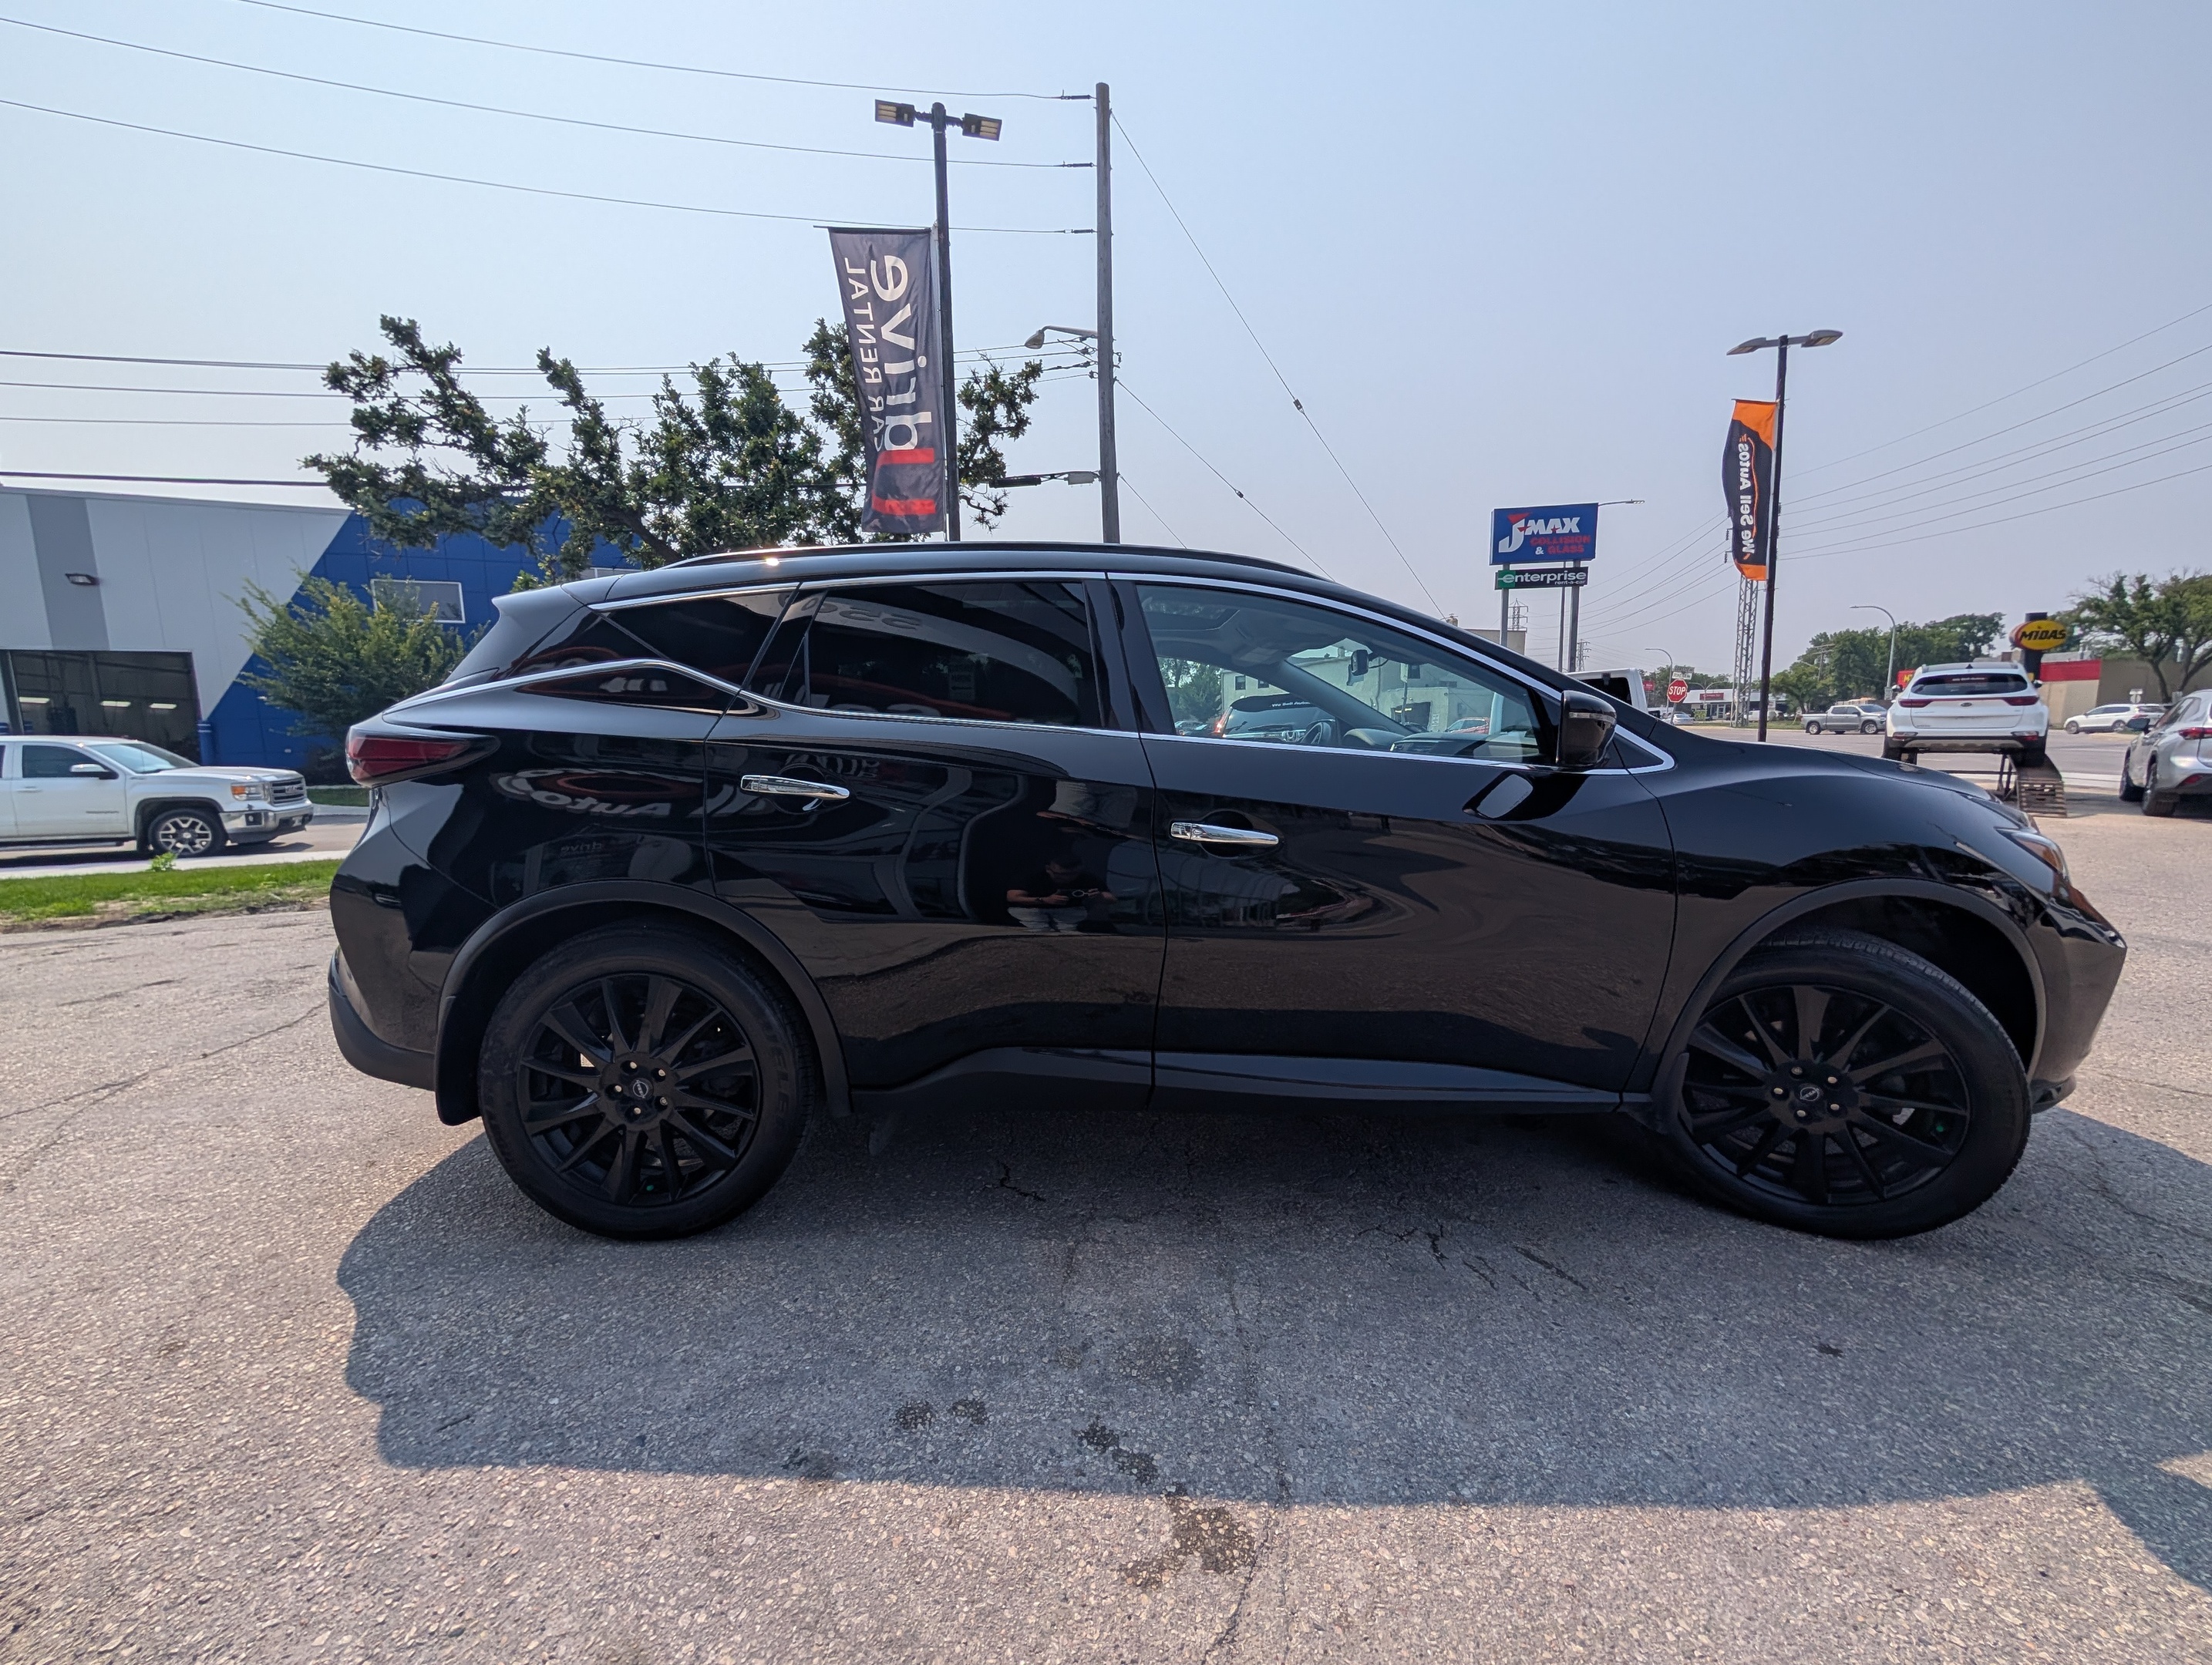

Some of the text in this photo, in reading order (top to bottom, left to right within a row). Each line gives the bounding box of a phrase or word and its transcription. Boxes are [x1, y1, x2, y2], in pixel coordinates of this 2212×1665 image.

[1535, 547, 1544, 555] &
[1503, 570, 1587, 584] enterprise
[2020, 629, 2066, 641] MIDAS
[1668, 686, 1686, 695] STOP
